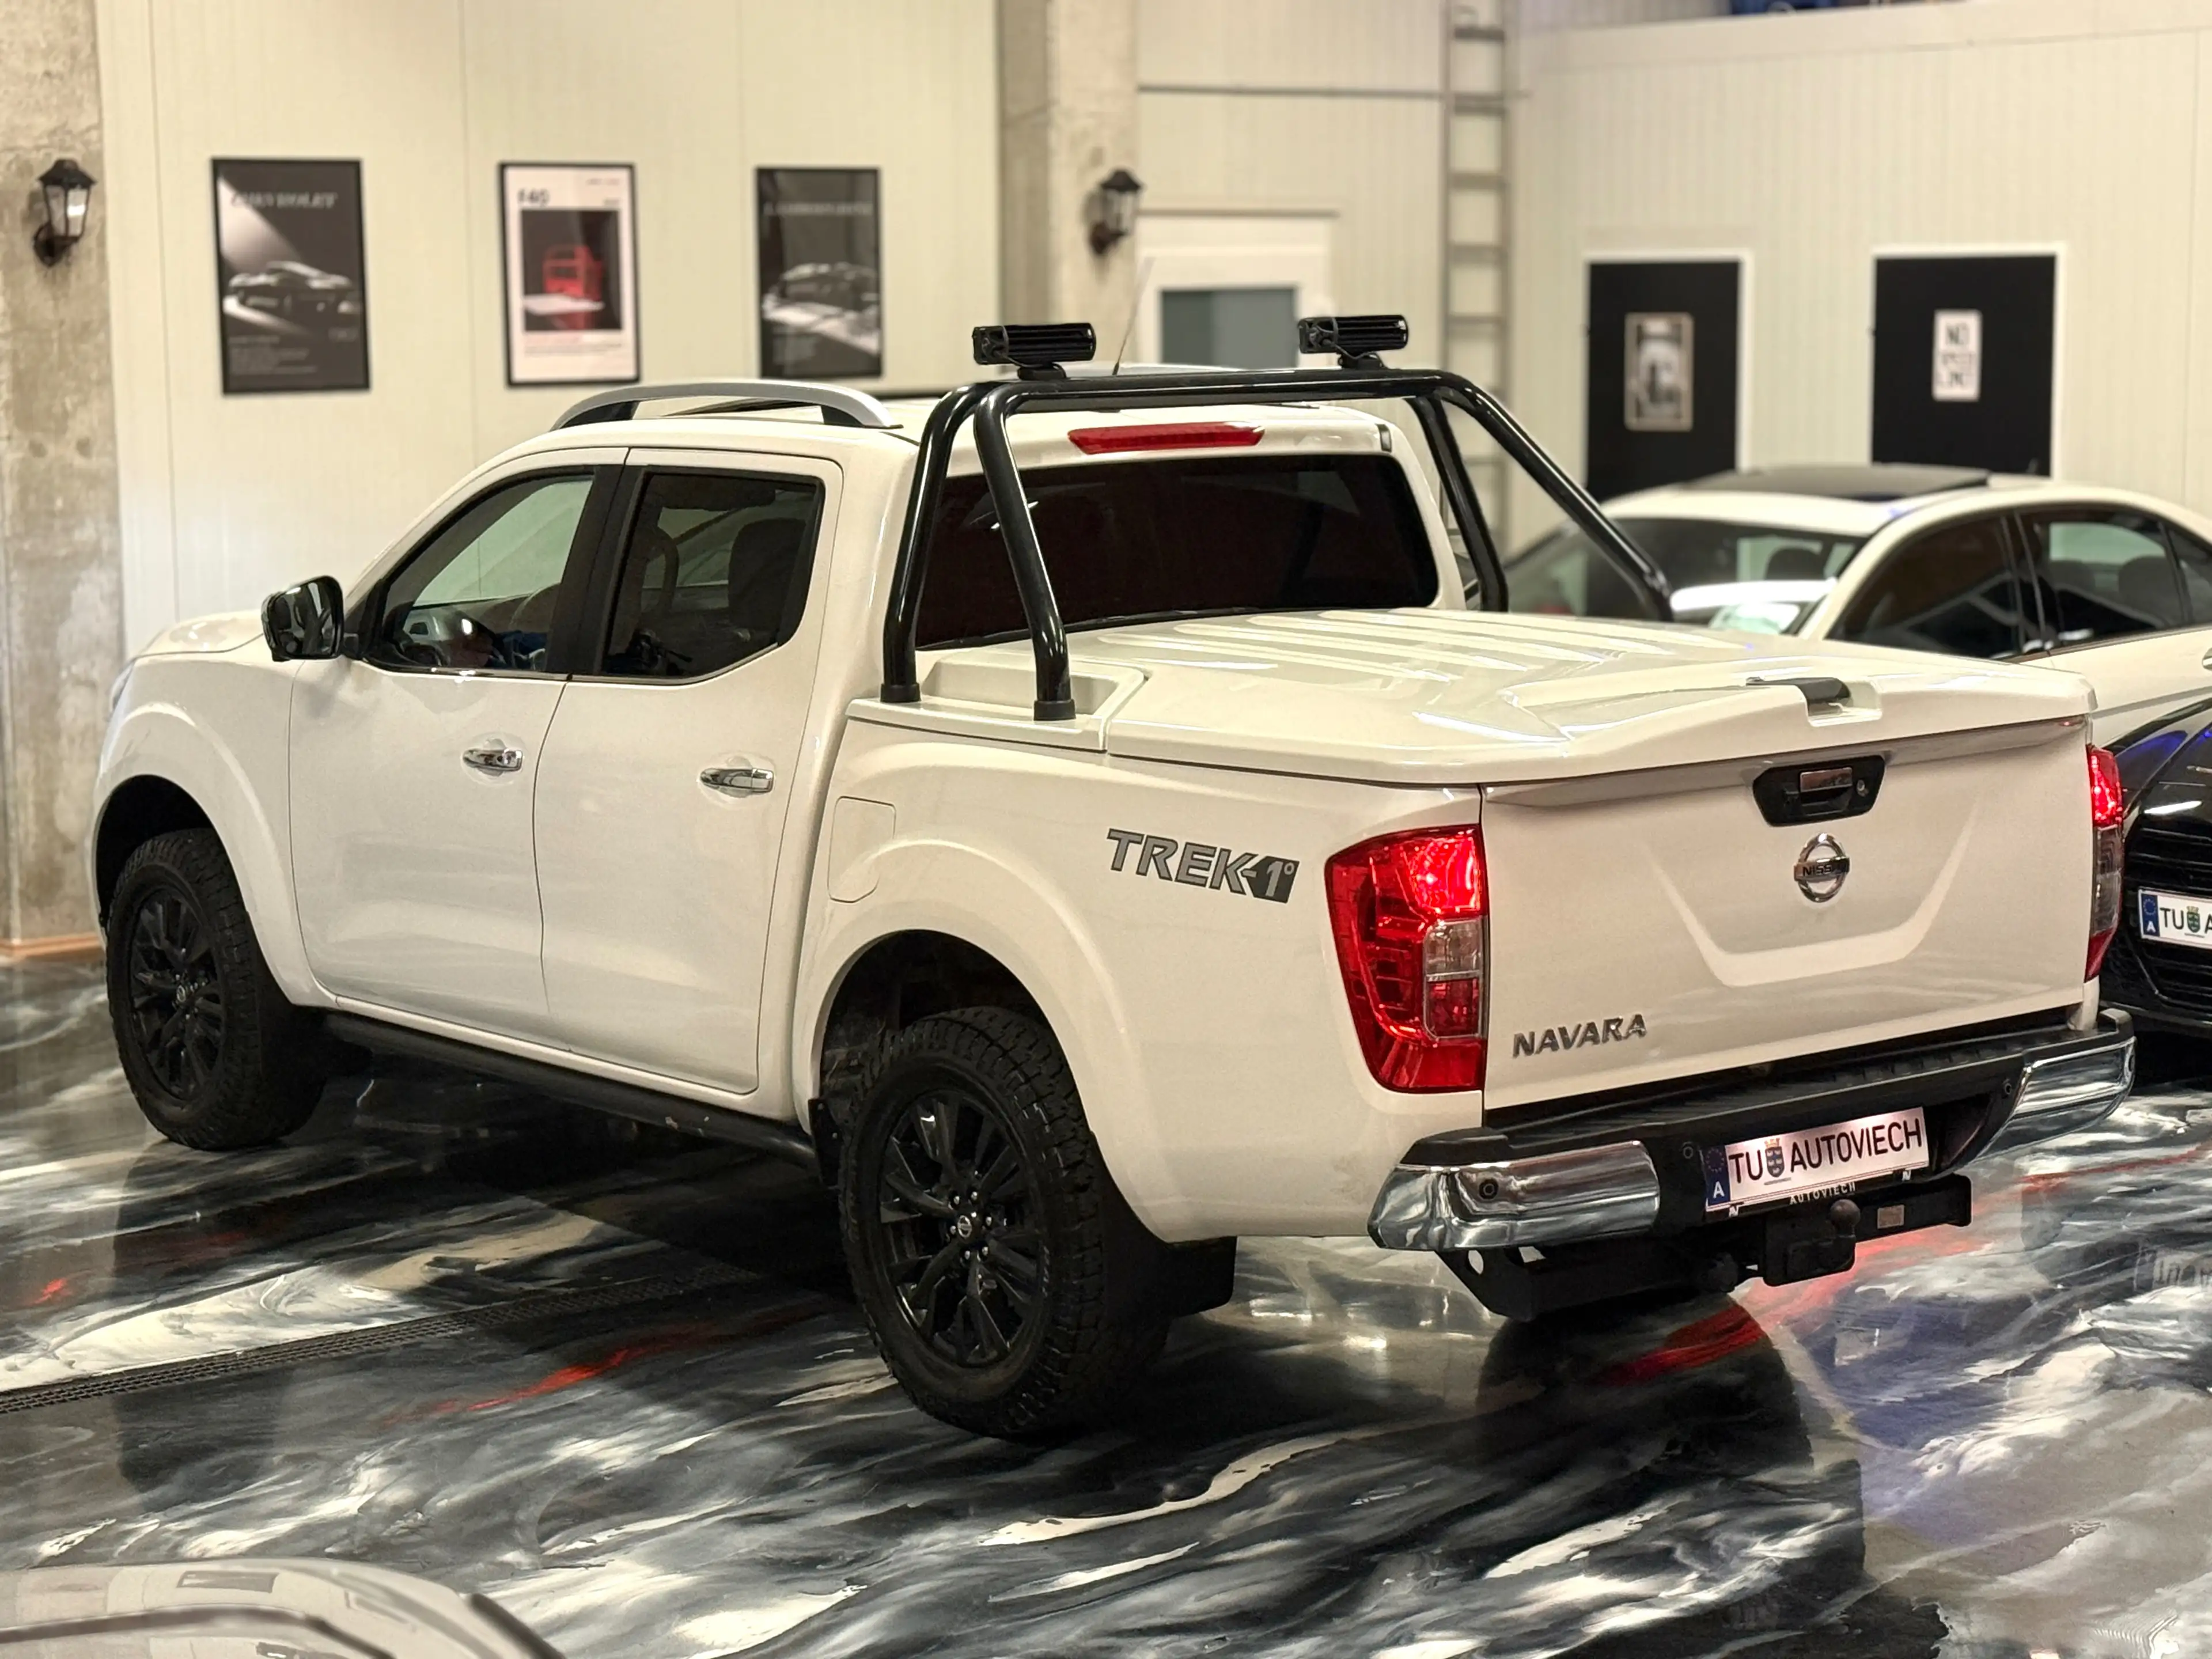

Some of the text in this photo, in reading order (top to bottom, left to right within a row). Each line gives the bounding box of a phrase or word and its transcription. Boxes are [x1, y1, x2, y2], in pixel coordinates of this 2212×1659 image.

[1802, 861, 1845, 876] NISS
[2146, 921, 2157, 933] A
[2159, 907, 2184, 930] TU
[1512, 1014, 1647, 1059] NAVARA
[1729, 1118, 1923, 1183] TU AUTOVIECH
[1713, 1181, 1725, 1199] A
[1789, 1181, 1856, 1205] AUTOVIECH
